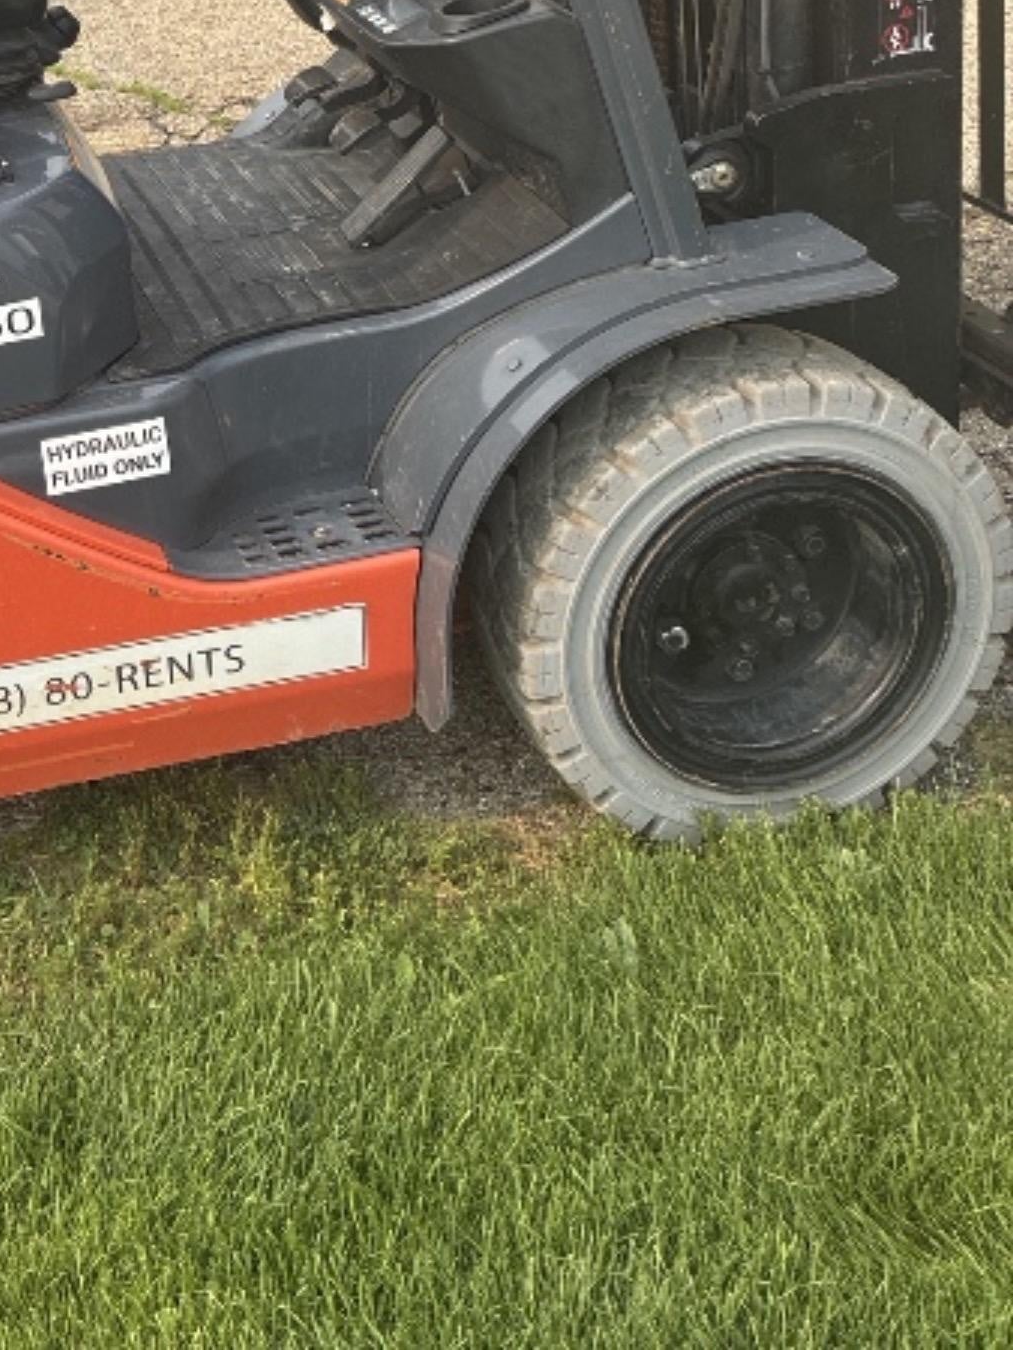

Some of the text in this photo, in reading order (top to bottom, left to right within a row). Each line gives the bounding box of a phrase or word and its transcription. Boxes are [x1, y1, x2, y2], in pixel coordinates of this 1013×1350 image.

[46, 425, 162, 464] HYDRAULIC
[51, 450, 165, 488] FLUID ONLY
[44, 643, 246, 707] 80-RENTS
